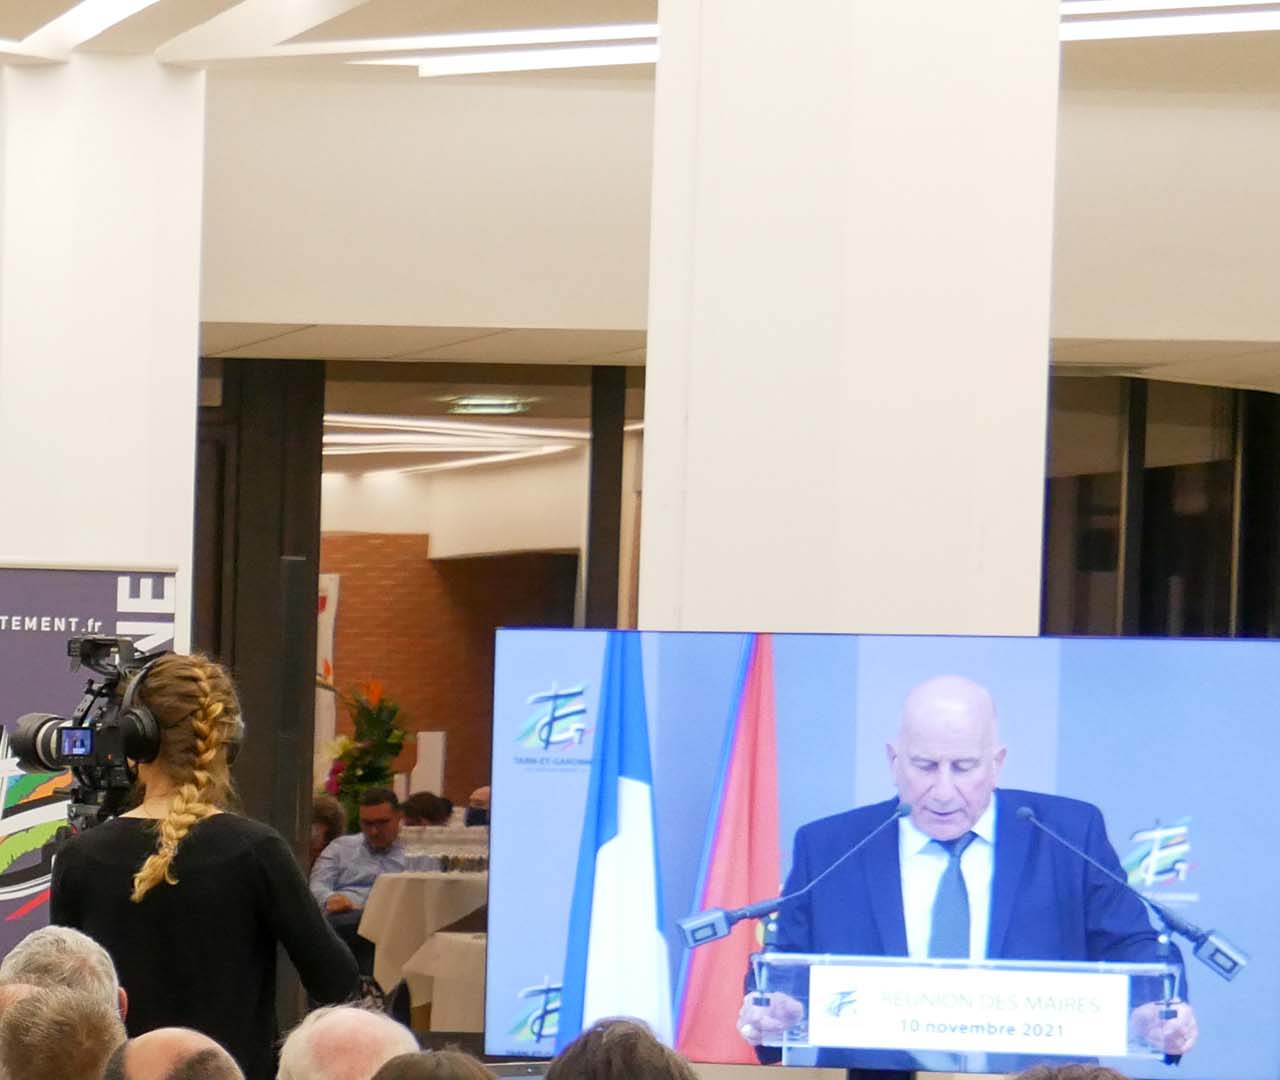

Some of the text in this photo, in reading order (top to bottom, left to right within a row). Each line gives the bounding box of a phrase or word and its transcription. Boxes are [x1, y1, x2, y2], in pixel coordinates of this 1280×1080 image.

[980, 993, 1019, 1011] DES
[1023, 994, 1101, 1013] MAIRES
[899, 1018, 1064, 1038] 10 novembre 2021
